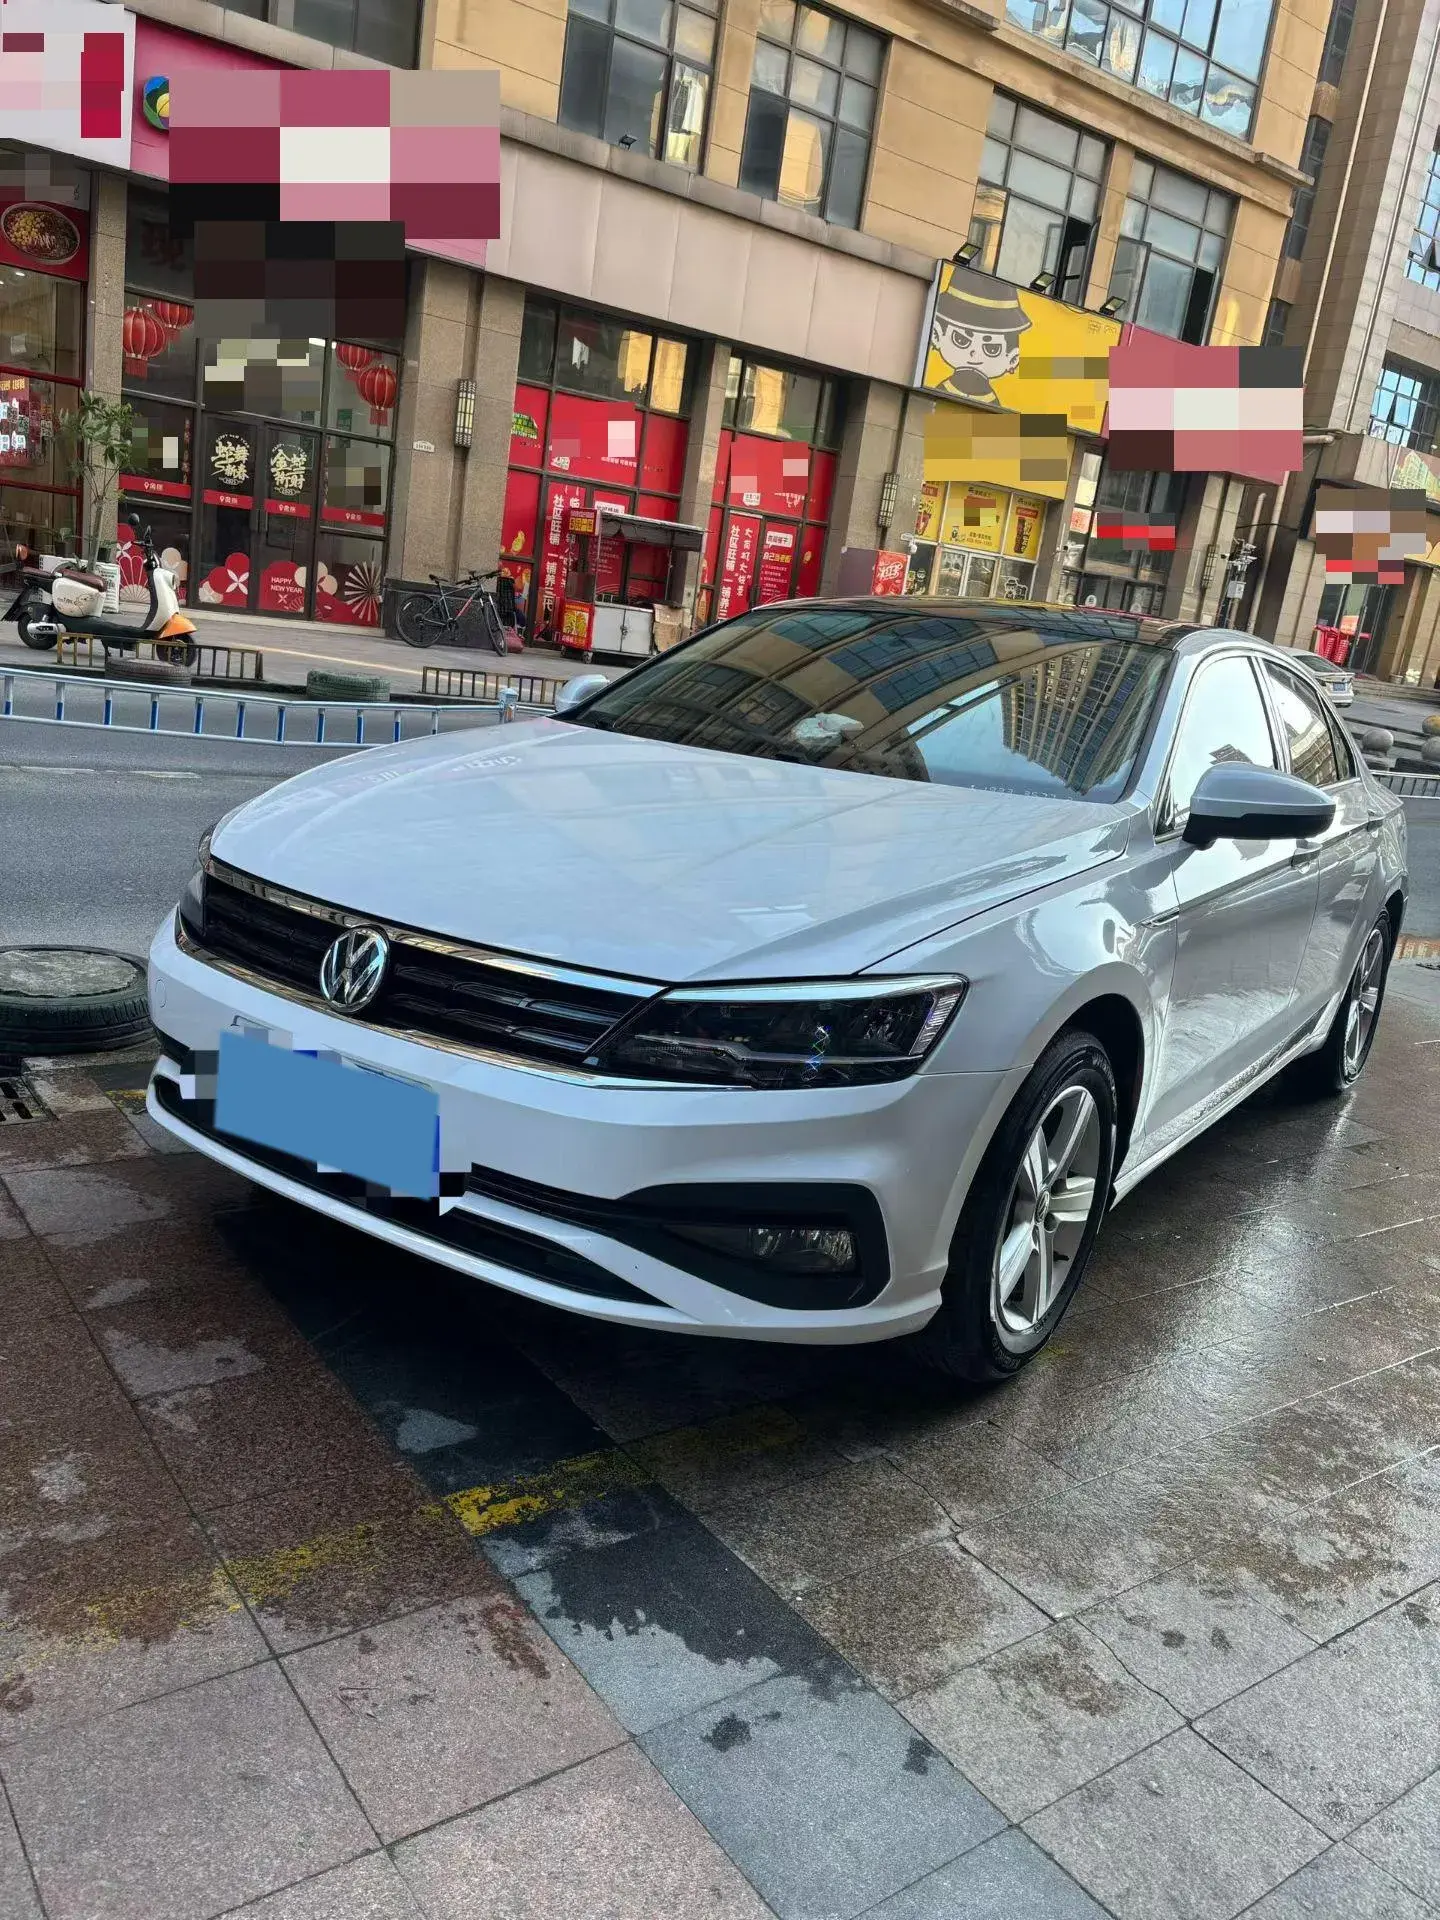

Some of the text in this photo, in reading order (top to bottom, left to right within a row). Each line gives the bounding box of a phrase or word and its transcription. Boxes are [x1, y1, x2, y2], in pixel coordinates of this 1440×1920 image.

[550, 494, 565, 546] 社区旺铺
[271, 576, 292, 585] HAPPY
[271, 584, 303, 594] NEW YEAR
[716, 525, 741, 623] 社区旺铺 一铺养三
